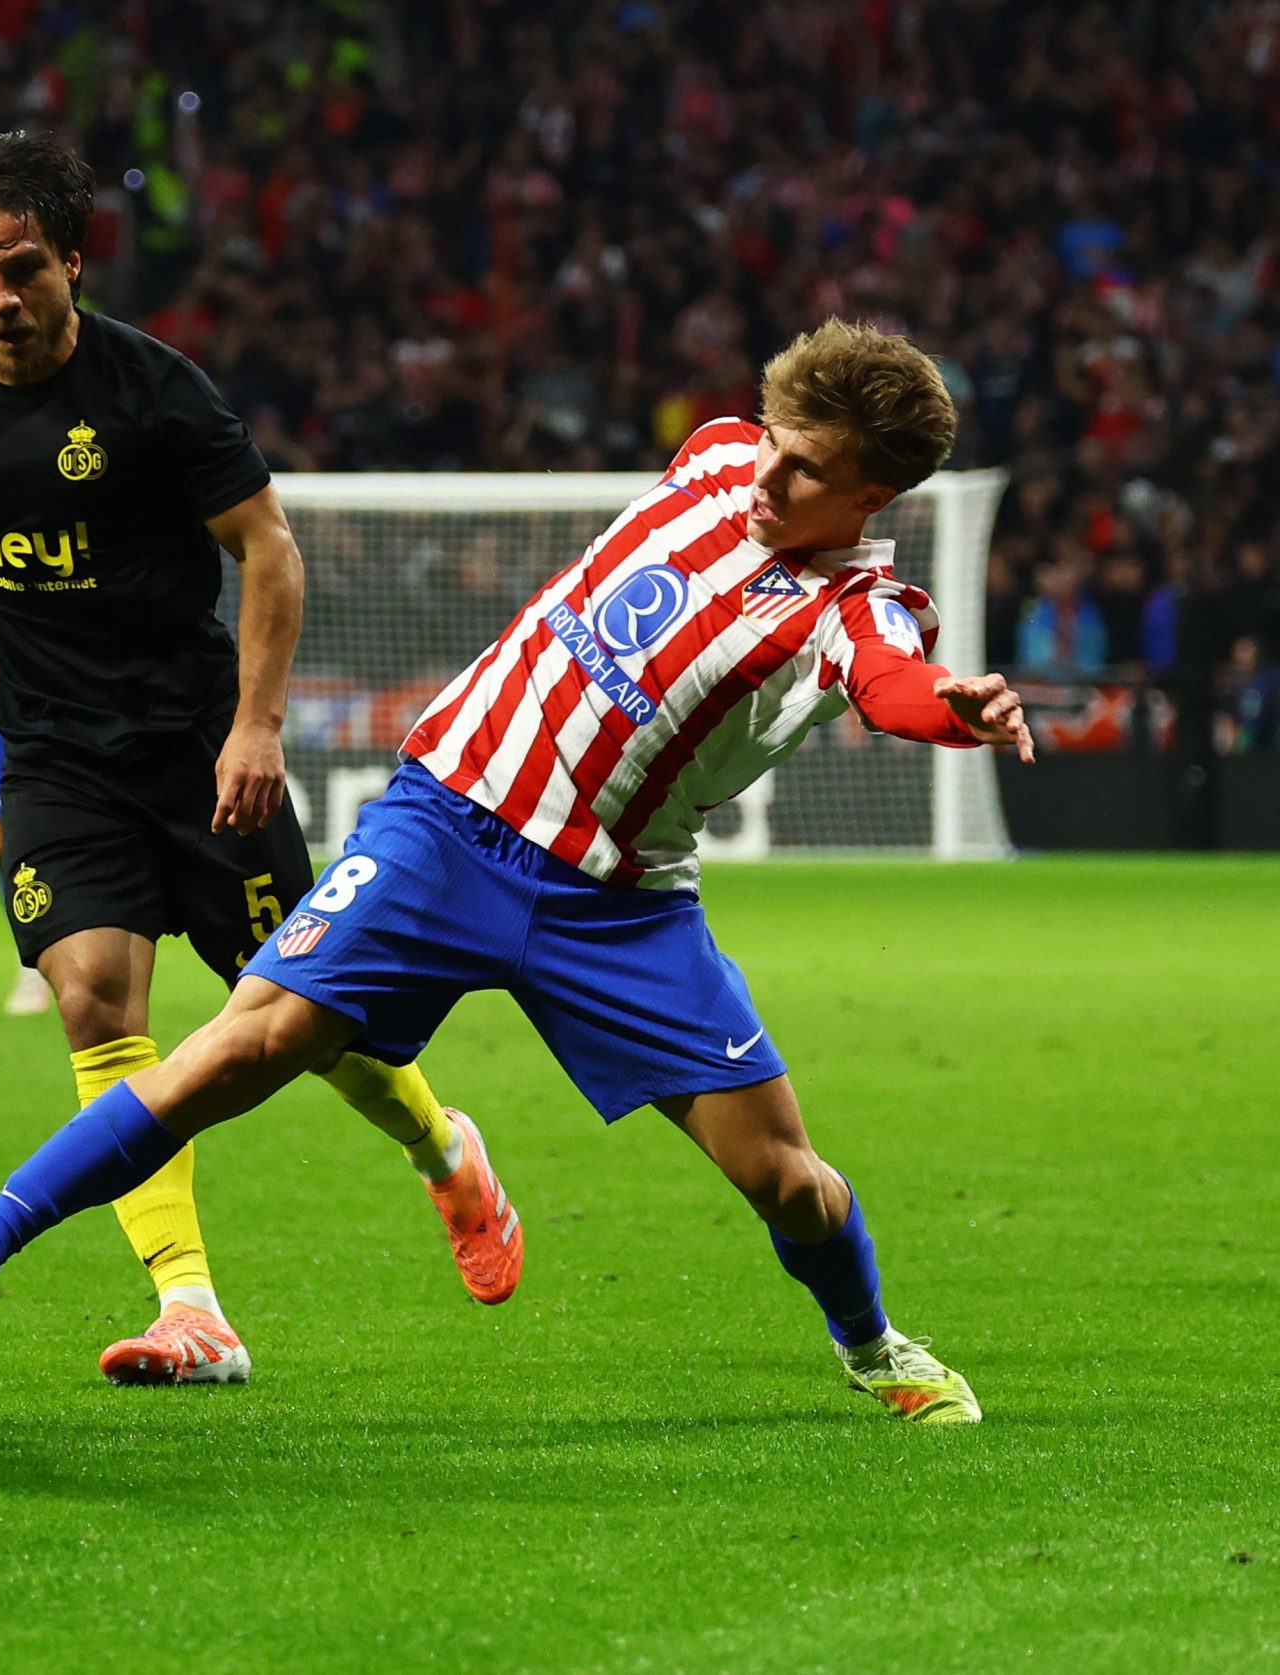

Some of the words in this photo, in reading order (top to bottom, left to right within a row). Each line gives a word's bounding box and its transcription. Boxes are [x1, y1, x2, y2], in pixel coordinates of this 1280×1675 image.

[548, 604, 616, 684] RIYADH
[607, 681, 651, 722] AIR
[243, 872, 284, 943] 5
[308, 854, 378, 913] 8
